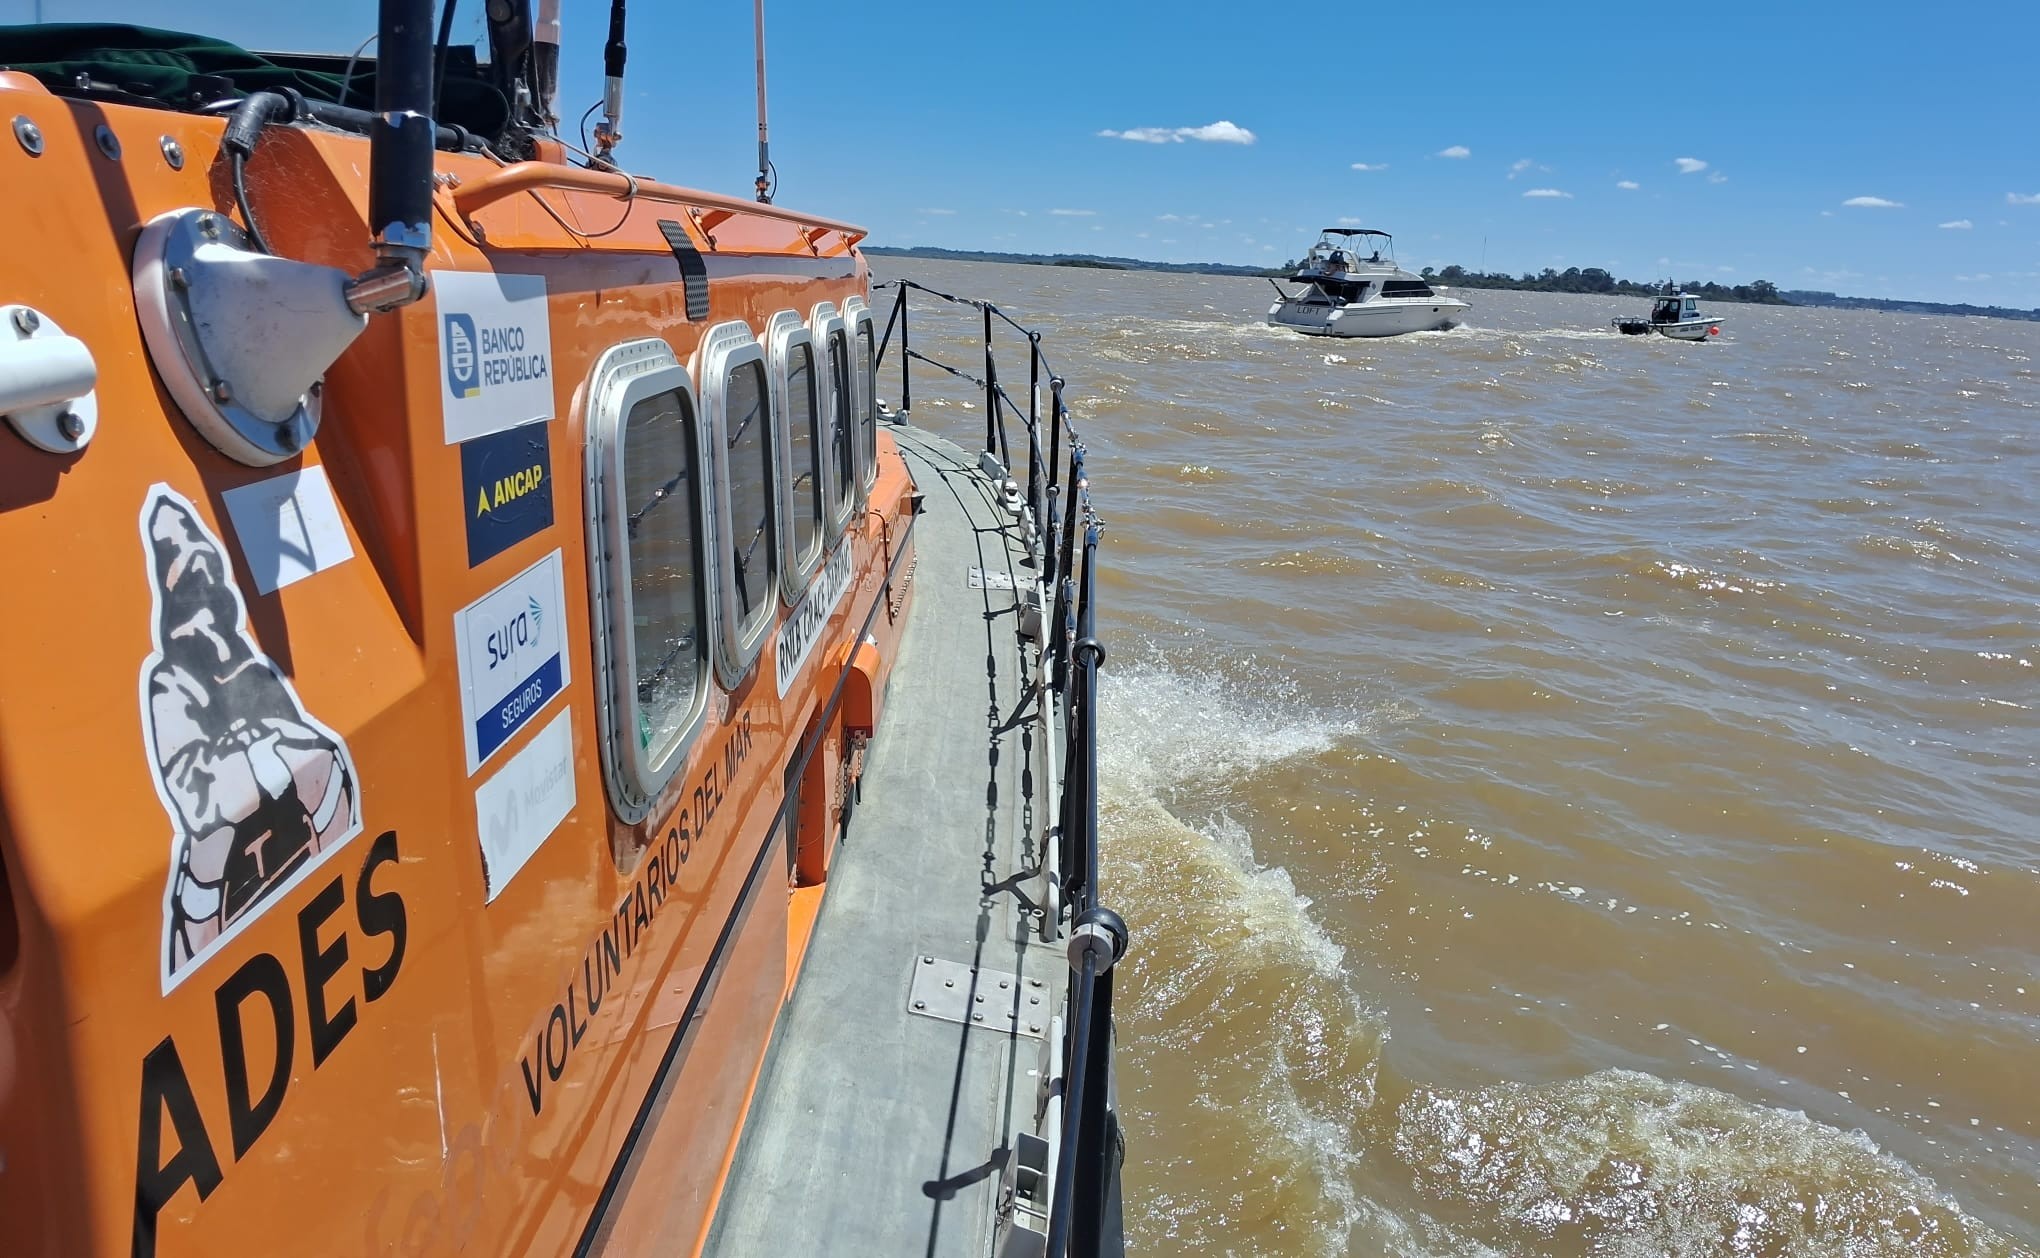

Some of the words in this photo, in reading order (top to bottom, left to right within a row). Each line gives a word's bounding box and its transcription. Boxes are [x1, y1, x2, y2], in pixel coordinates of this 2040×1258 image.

[481, 327, 525, 355] BANCO
[483, 355, 548, 387] REPÚBLICA
[494, 464, 543, 508] ANCAP
[487, 611, 528, 671] sura
[779, 620, 802, 685] RNLB
[803, 582, 826, 644] GRACE
[501, 678, 543, 729] SEGUROS
[524, 756, 568, 816] Movistar
[521, 808, 690, 1117] VOLUNTARIOS
[693, 762, 723, 842] DEL
[725, 710, 752, 788] MAR
[131, 830, 408, 1258] ADES
